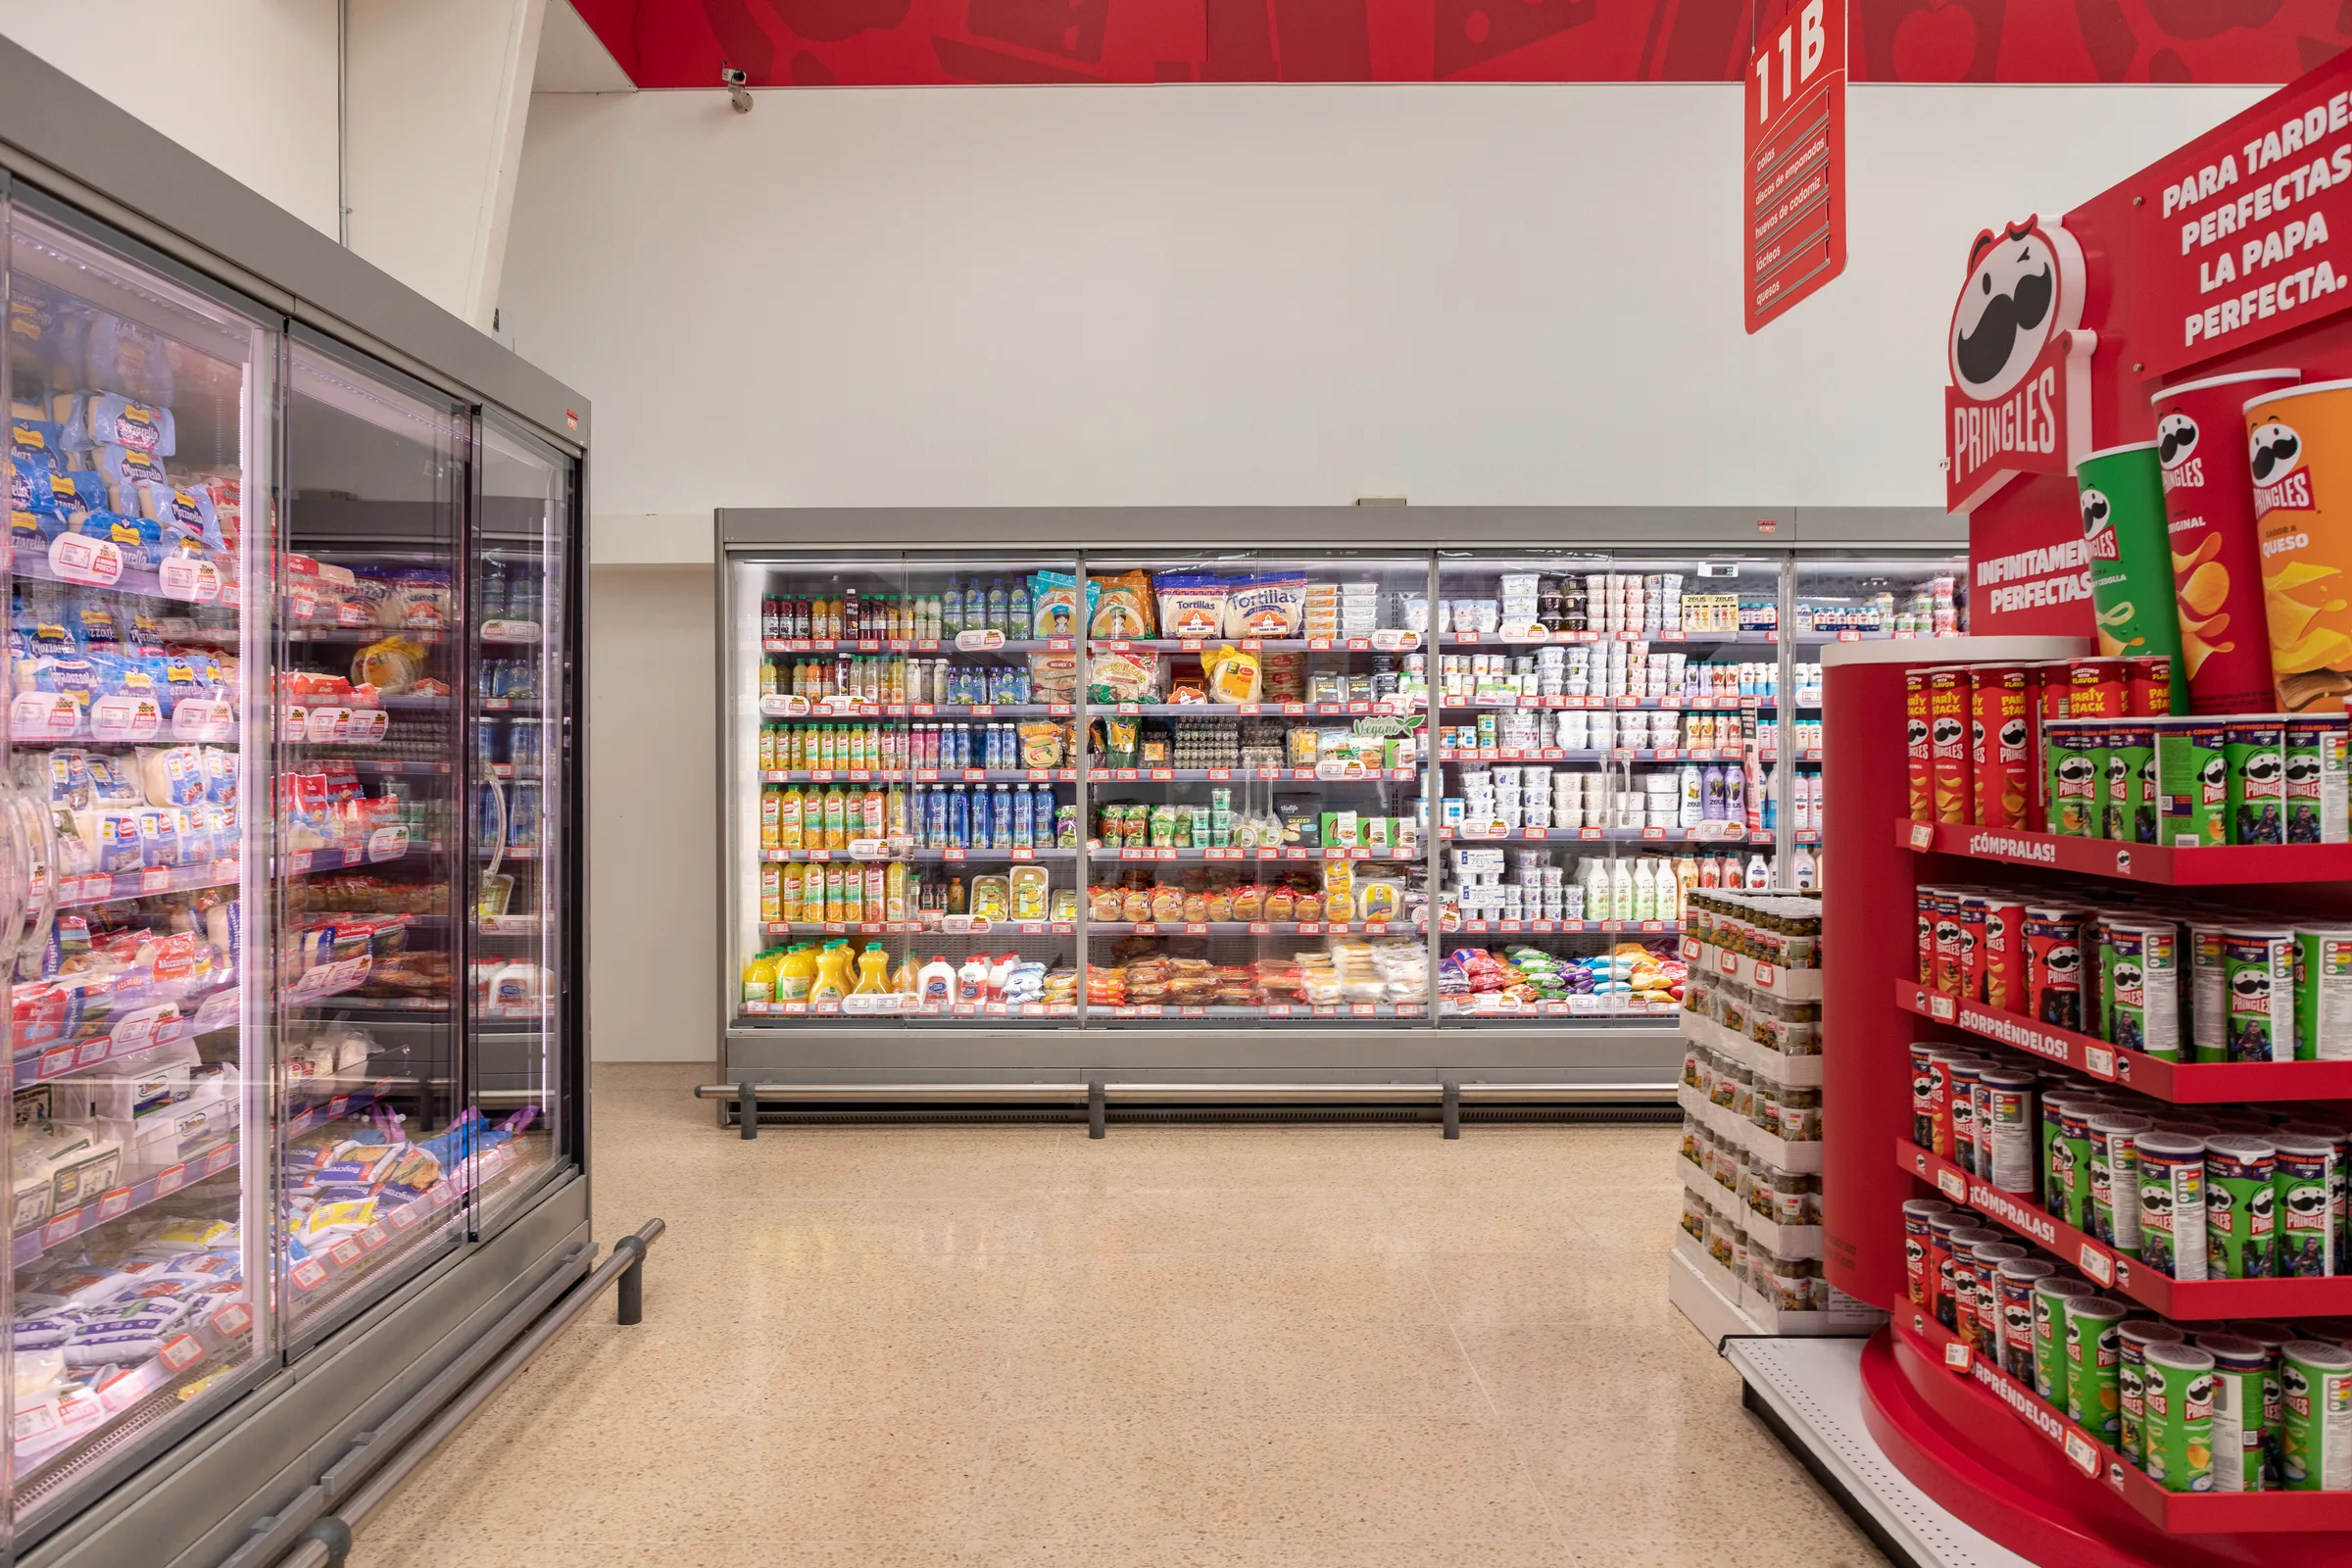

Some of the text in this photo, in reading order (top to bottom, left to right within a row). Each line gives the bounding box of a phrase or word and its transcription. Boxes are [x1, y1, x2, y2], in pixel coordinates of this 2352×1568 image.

[1756, 0, 1825, 125] 11B
[1756, 147, 1776, 172] colas
[2163, 89, 2352, 220] PARA TARDE
[1755, 137, 1825, 207] discos de empanadas
[1755, 174, 1821, 240] huevos de codorniz
[2181, 144, 2352, 256] PERFECTAS
[1755, 244, 1781, 273] lácteos
[2200, 211, 2328, 294] LA PAPA
[1756, 280, 1780, 307] quesos
[2184, 260, 2348, 348] PERFECTA.
[1954, 366, 2056, 485] PRINGLES
[2262, 533, 2309, 559] QUESO
[1977, 538, 2091, 587] INFINITAMEN
[1176, 600, 1215, 611] Tortillas
[1226, 589, 1298, 611] Tortillas
[1990, 570, 2094, 614] PERFECTAS
[1096, 662, 1147, 683] TORTILLAS
[138, 705, 155, 713] TODO
[1932, 691, 1961, 707] PARTY
[2070, 687, 2105, 702] PARTY
[2070, 701, 2106, 713] STACK
[1932, 705, 1961, 715] STACK
[1354, 719, 1399, 738] Vegano
[1933, 743, 1963, 760] PRINGLES
[1970, 832, 2056, 862] ¡CÓMPRALAS!
[1960, 1009, 2068, 1060] ¡SORPRÉNDELOS!
[1970, 1187, 2055, 1245] ¡CÓMPRALAS!
[1971, 1361, 2063, 1444] RPRÉNDELOS!
